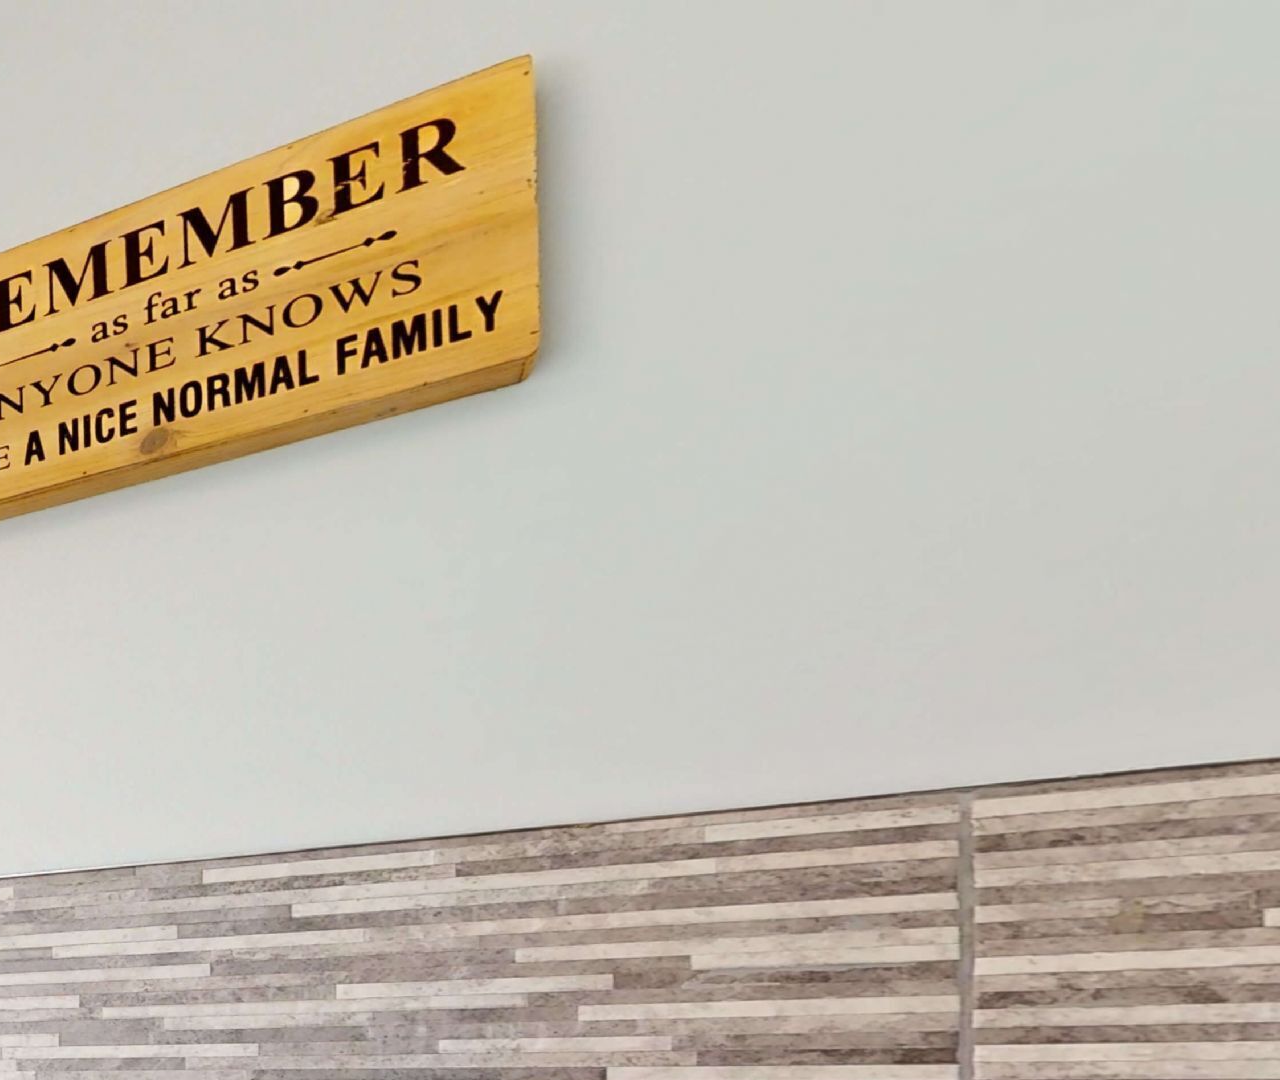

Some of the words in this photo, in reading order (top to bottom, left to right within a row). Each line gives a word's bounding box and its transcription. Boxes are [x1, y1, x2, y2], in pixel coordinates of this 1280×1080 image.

[91, 314, 130, 342] as
[143, 287, 201, 326] far
[217, 268, 260, 301] as
[197, 259, 423, 357] KNOWS
[24, 430, 46, 466] A
[58, 399, 138, 453] NICE
[151, 349, 320, 423] NORMAL
[338, 289, 505, 376] FAMILY
